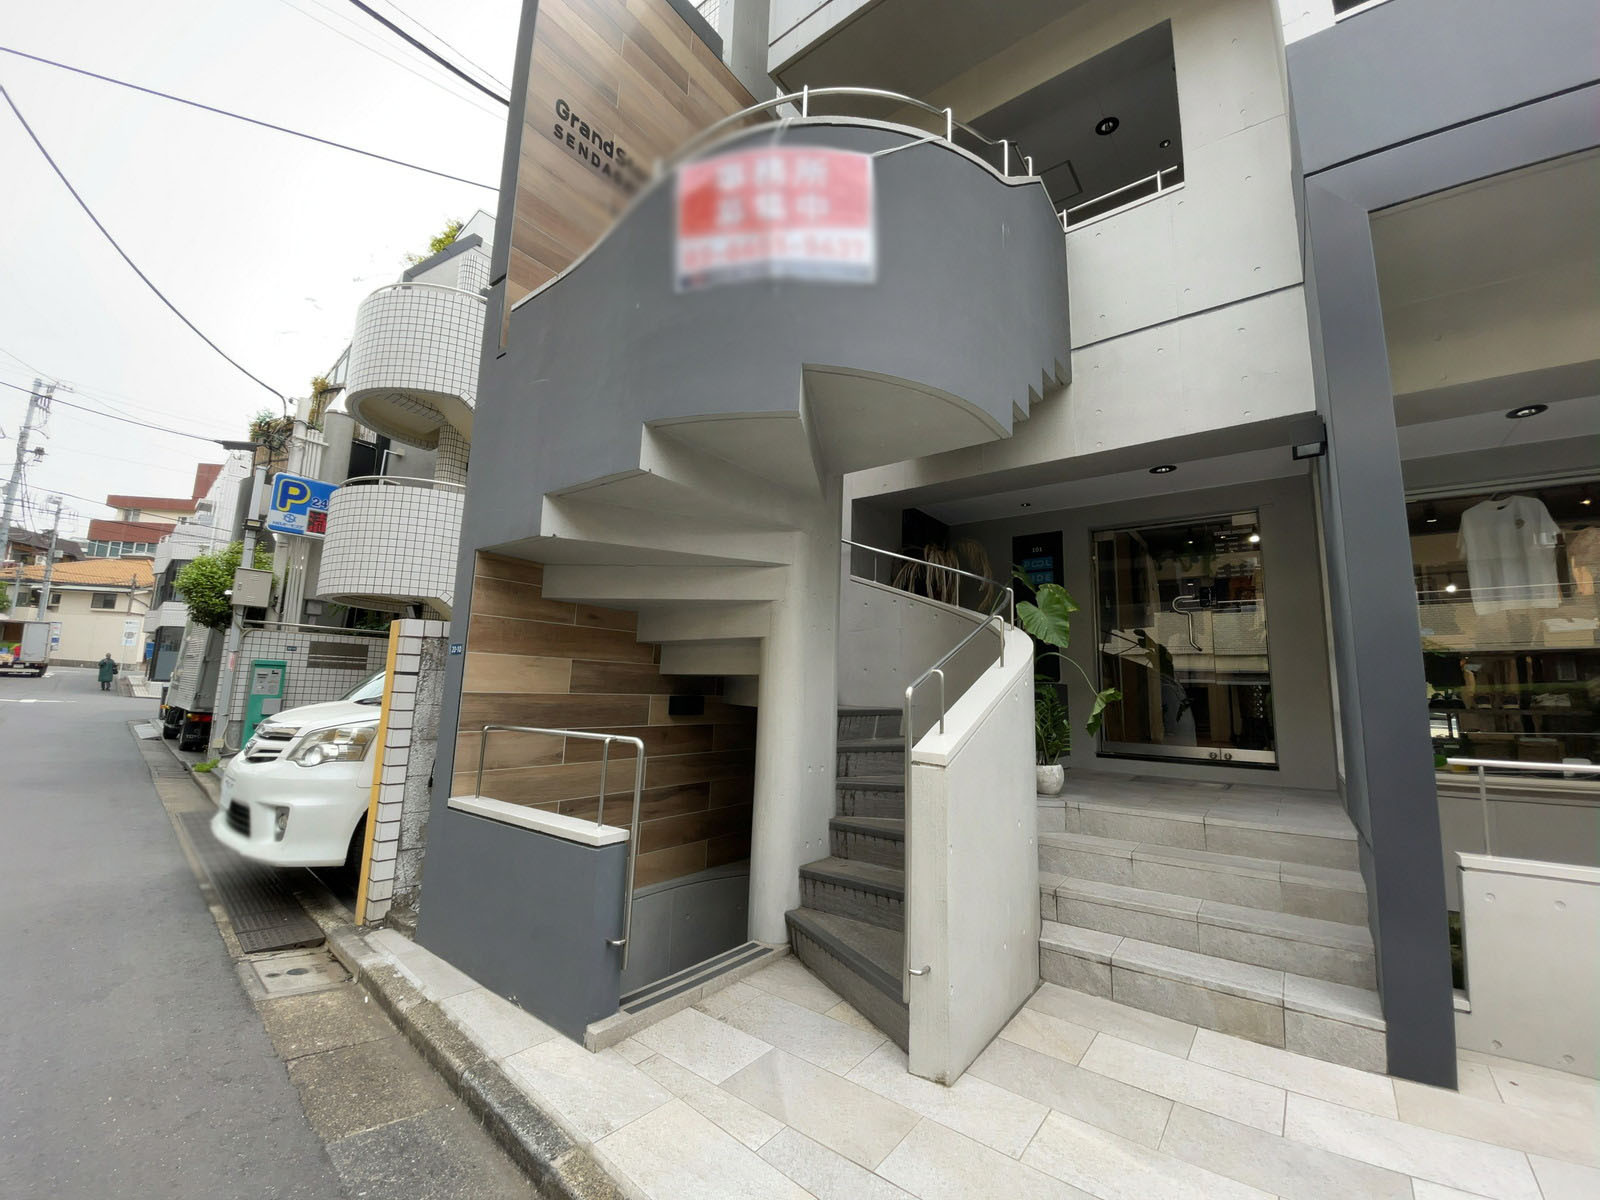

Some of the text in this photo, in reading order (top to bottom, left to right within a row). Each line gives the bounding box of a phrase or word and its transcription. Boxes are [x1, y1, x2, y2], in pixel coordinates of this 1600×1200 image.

[553, 123, 637, 194] SENDA
[555, 98, 648, 182] GrandS
[276, 478, 311, 512] P
